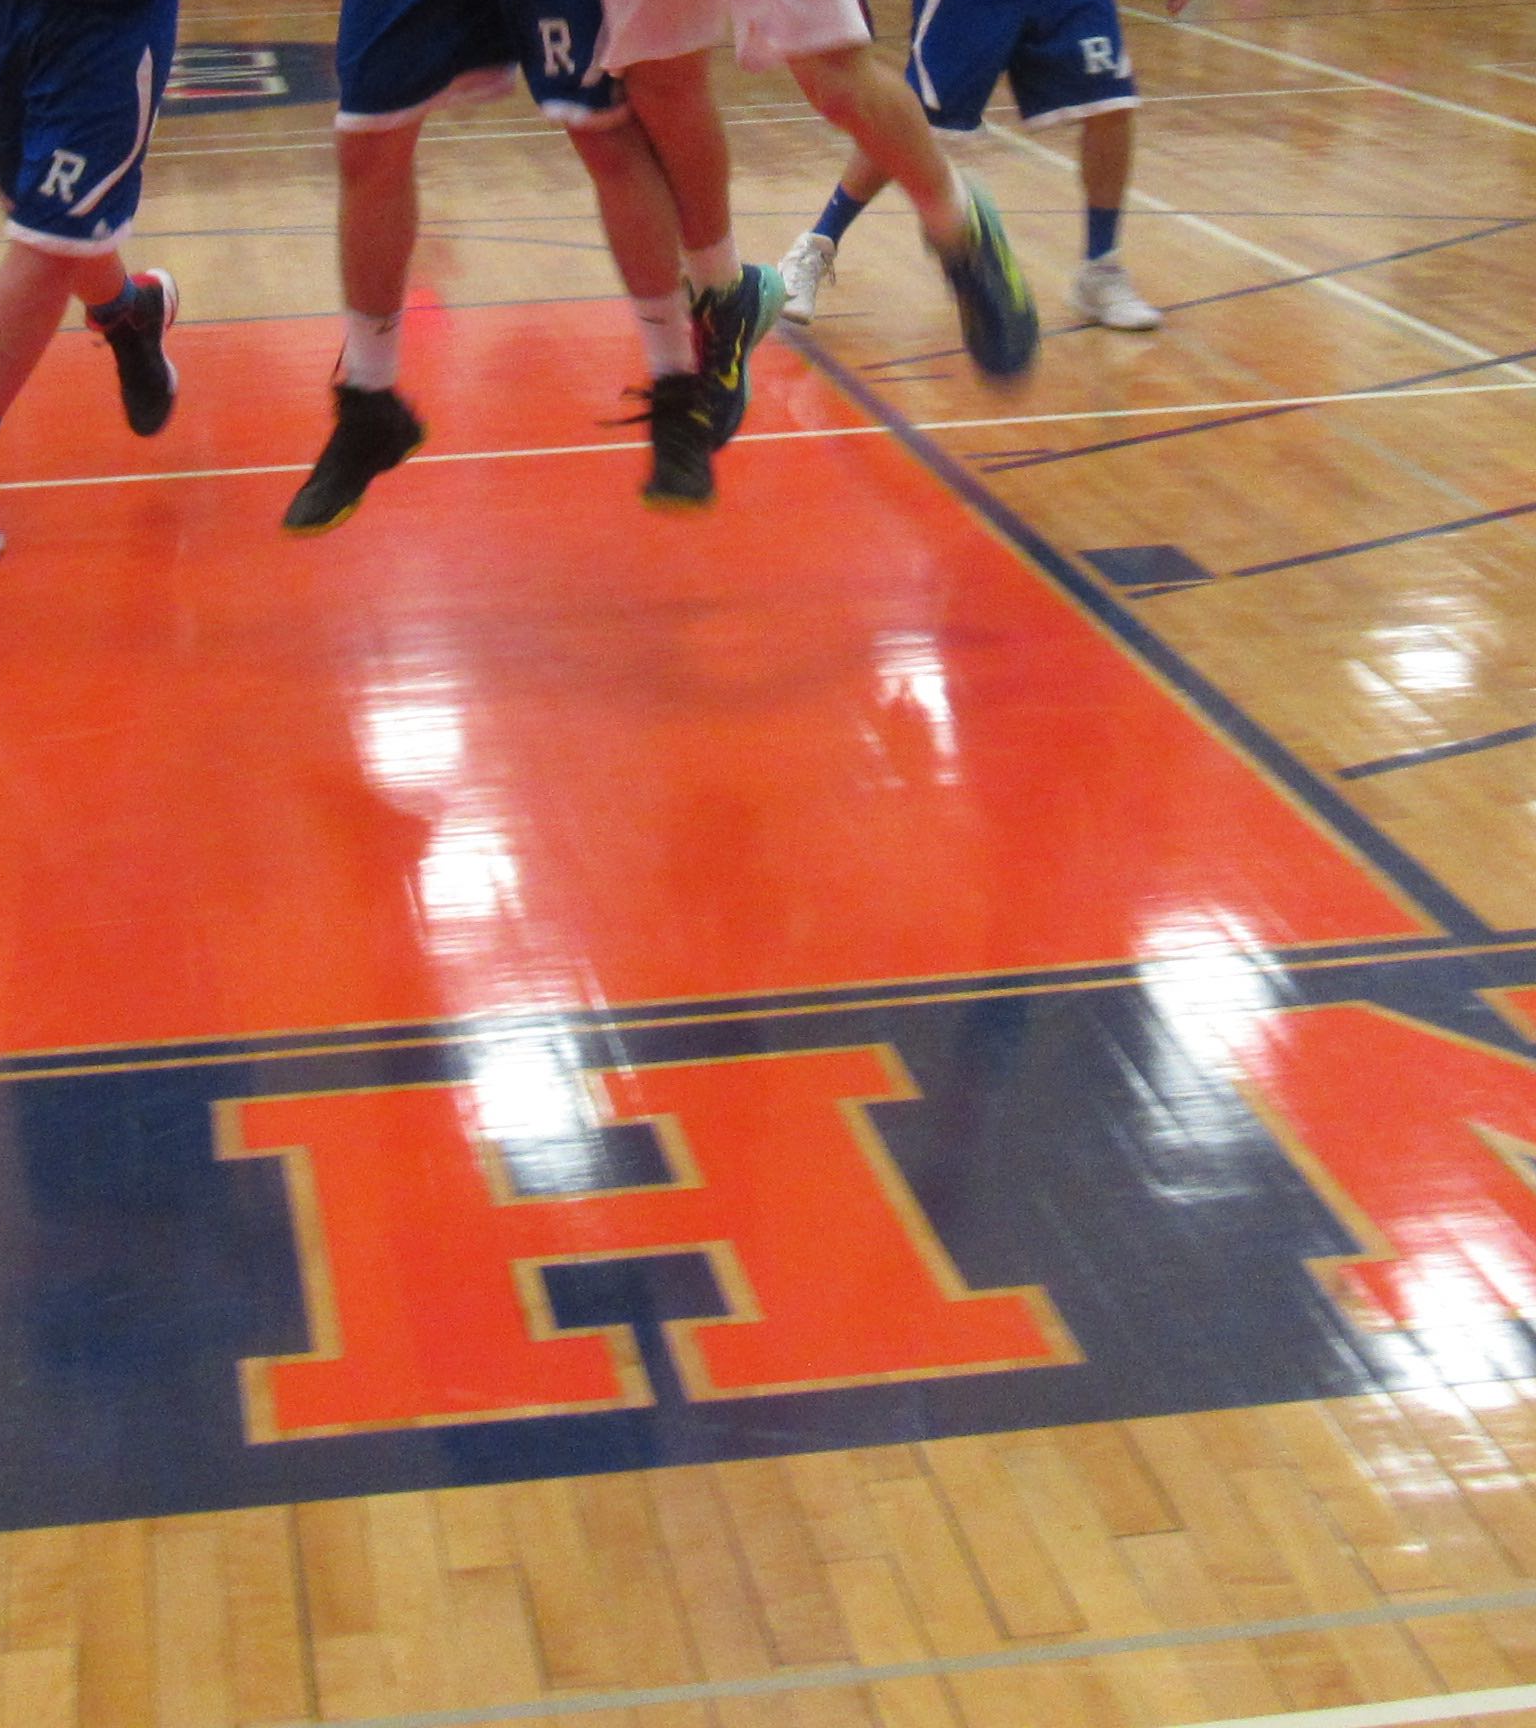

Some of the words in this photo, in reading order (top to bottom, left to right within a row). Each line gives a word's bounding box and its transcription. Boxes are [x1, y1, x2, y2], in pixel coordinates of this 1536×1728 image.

[538, 18, 576, 77] R
[1079, 36, 1120, 74] R
[39, 148, 86, 203] R
